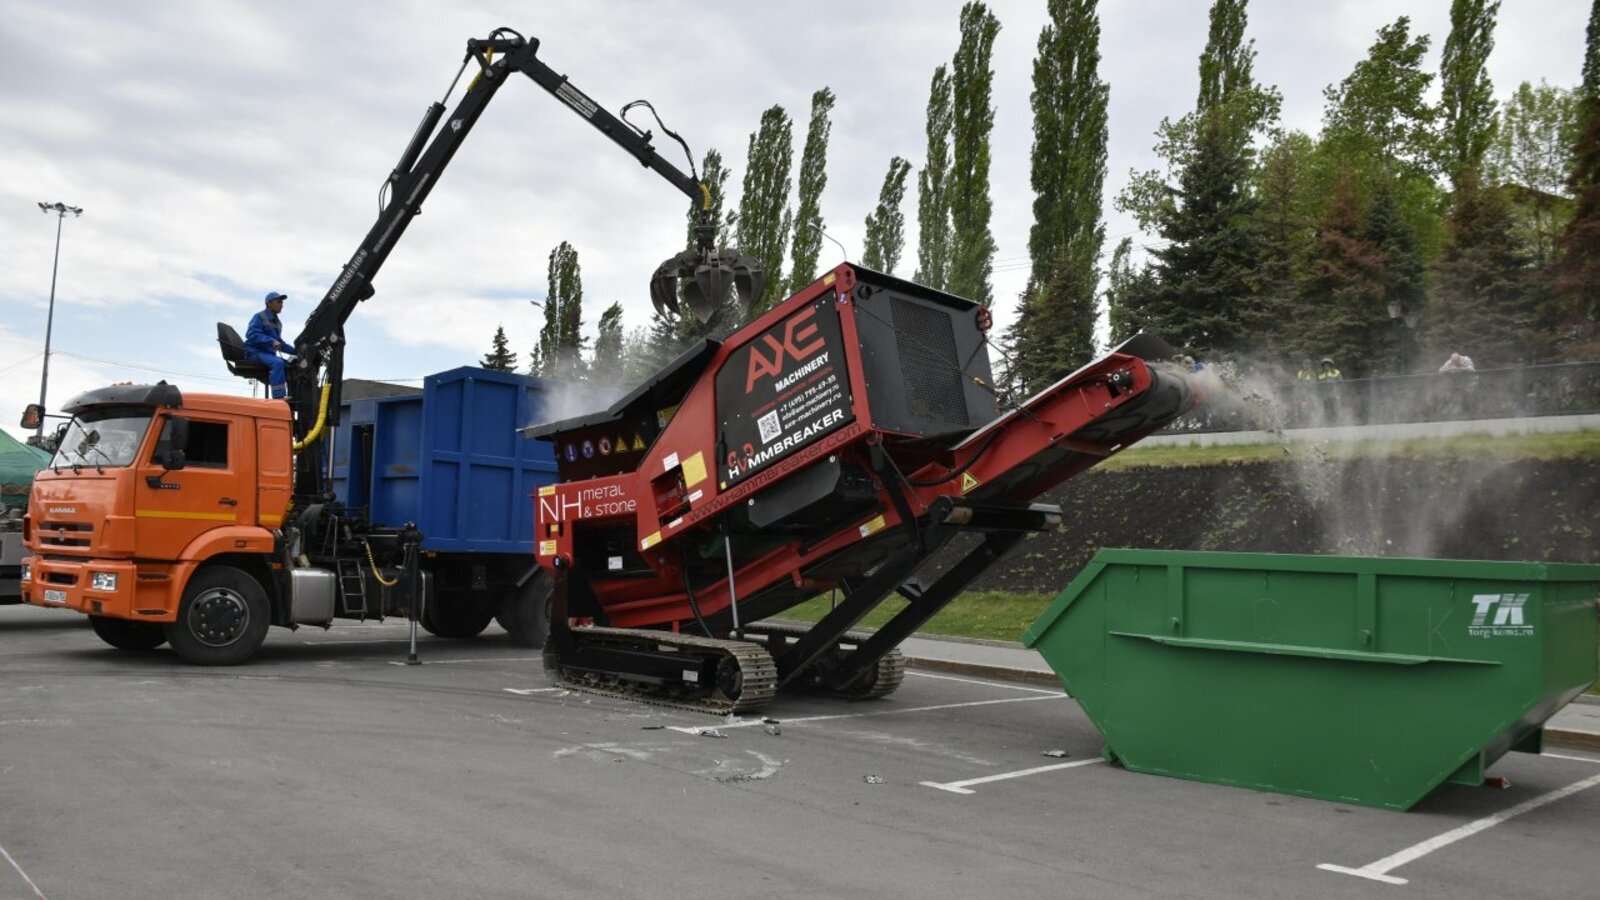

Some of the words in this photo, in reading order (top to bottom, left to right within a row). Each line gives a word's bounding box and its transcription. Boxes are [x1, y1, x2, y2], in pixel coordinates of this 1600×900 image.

[745, 305, 826, 394] AXE
[774, 351, 829, 392] MACHINERY
[784, 392, 842, 430] axe-machinery.ru
[540, 490, 582, 524] NH
[583, 506, 592, 518] &
